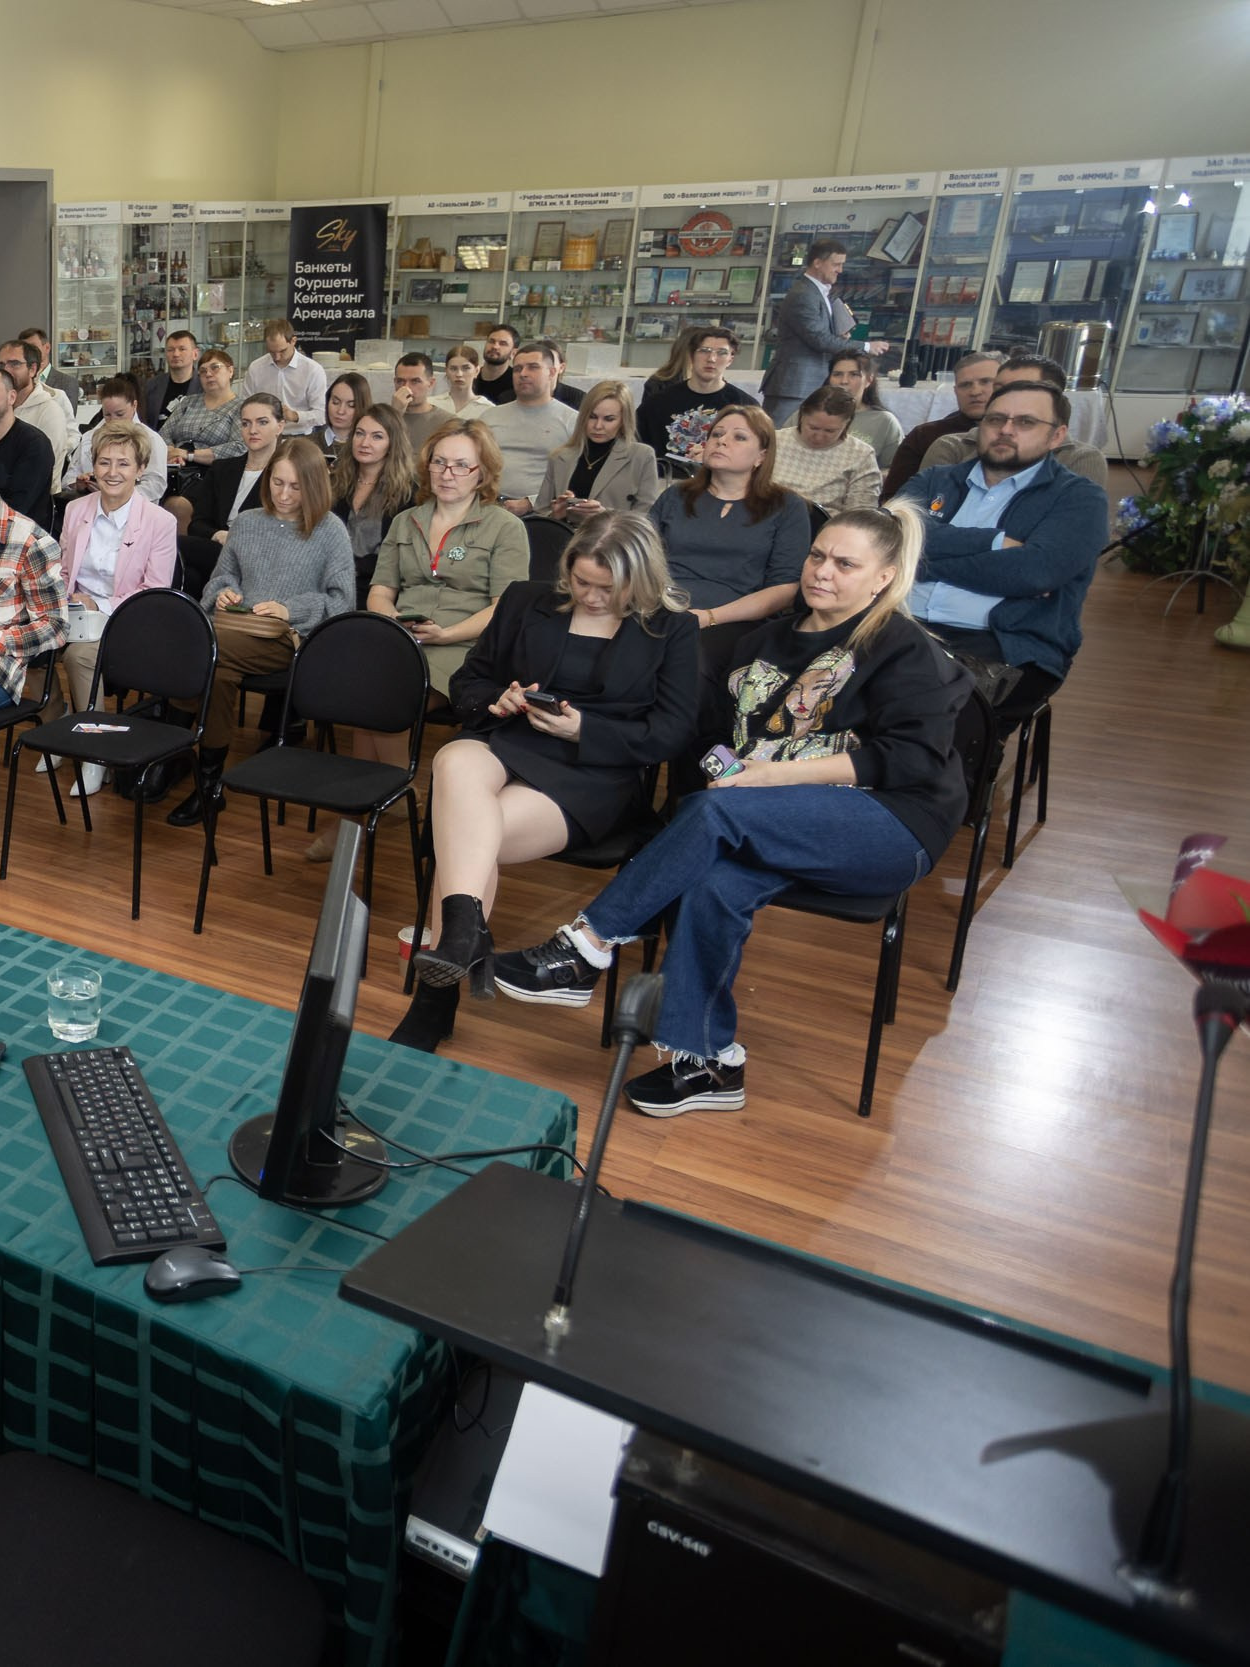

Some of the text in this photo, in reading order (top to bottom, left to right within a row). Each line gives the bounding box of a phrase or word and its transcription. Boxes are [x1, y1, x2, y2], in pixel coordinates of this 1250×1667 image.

[949, 171, 998, 180] Вологодский
[943, 181, 976, 190] учебный
[792, 222, 851, 233] Северсталь
[316, 219, 357, 252] Sky
[295, 261, 351, 273] Банкеты
[294, 276, 358, 291] Фуршеты
[293, 292, 364, 306] Кейтеринг
[292, 307, 375, 321] Аренда зала
